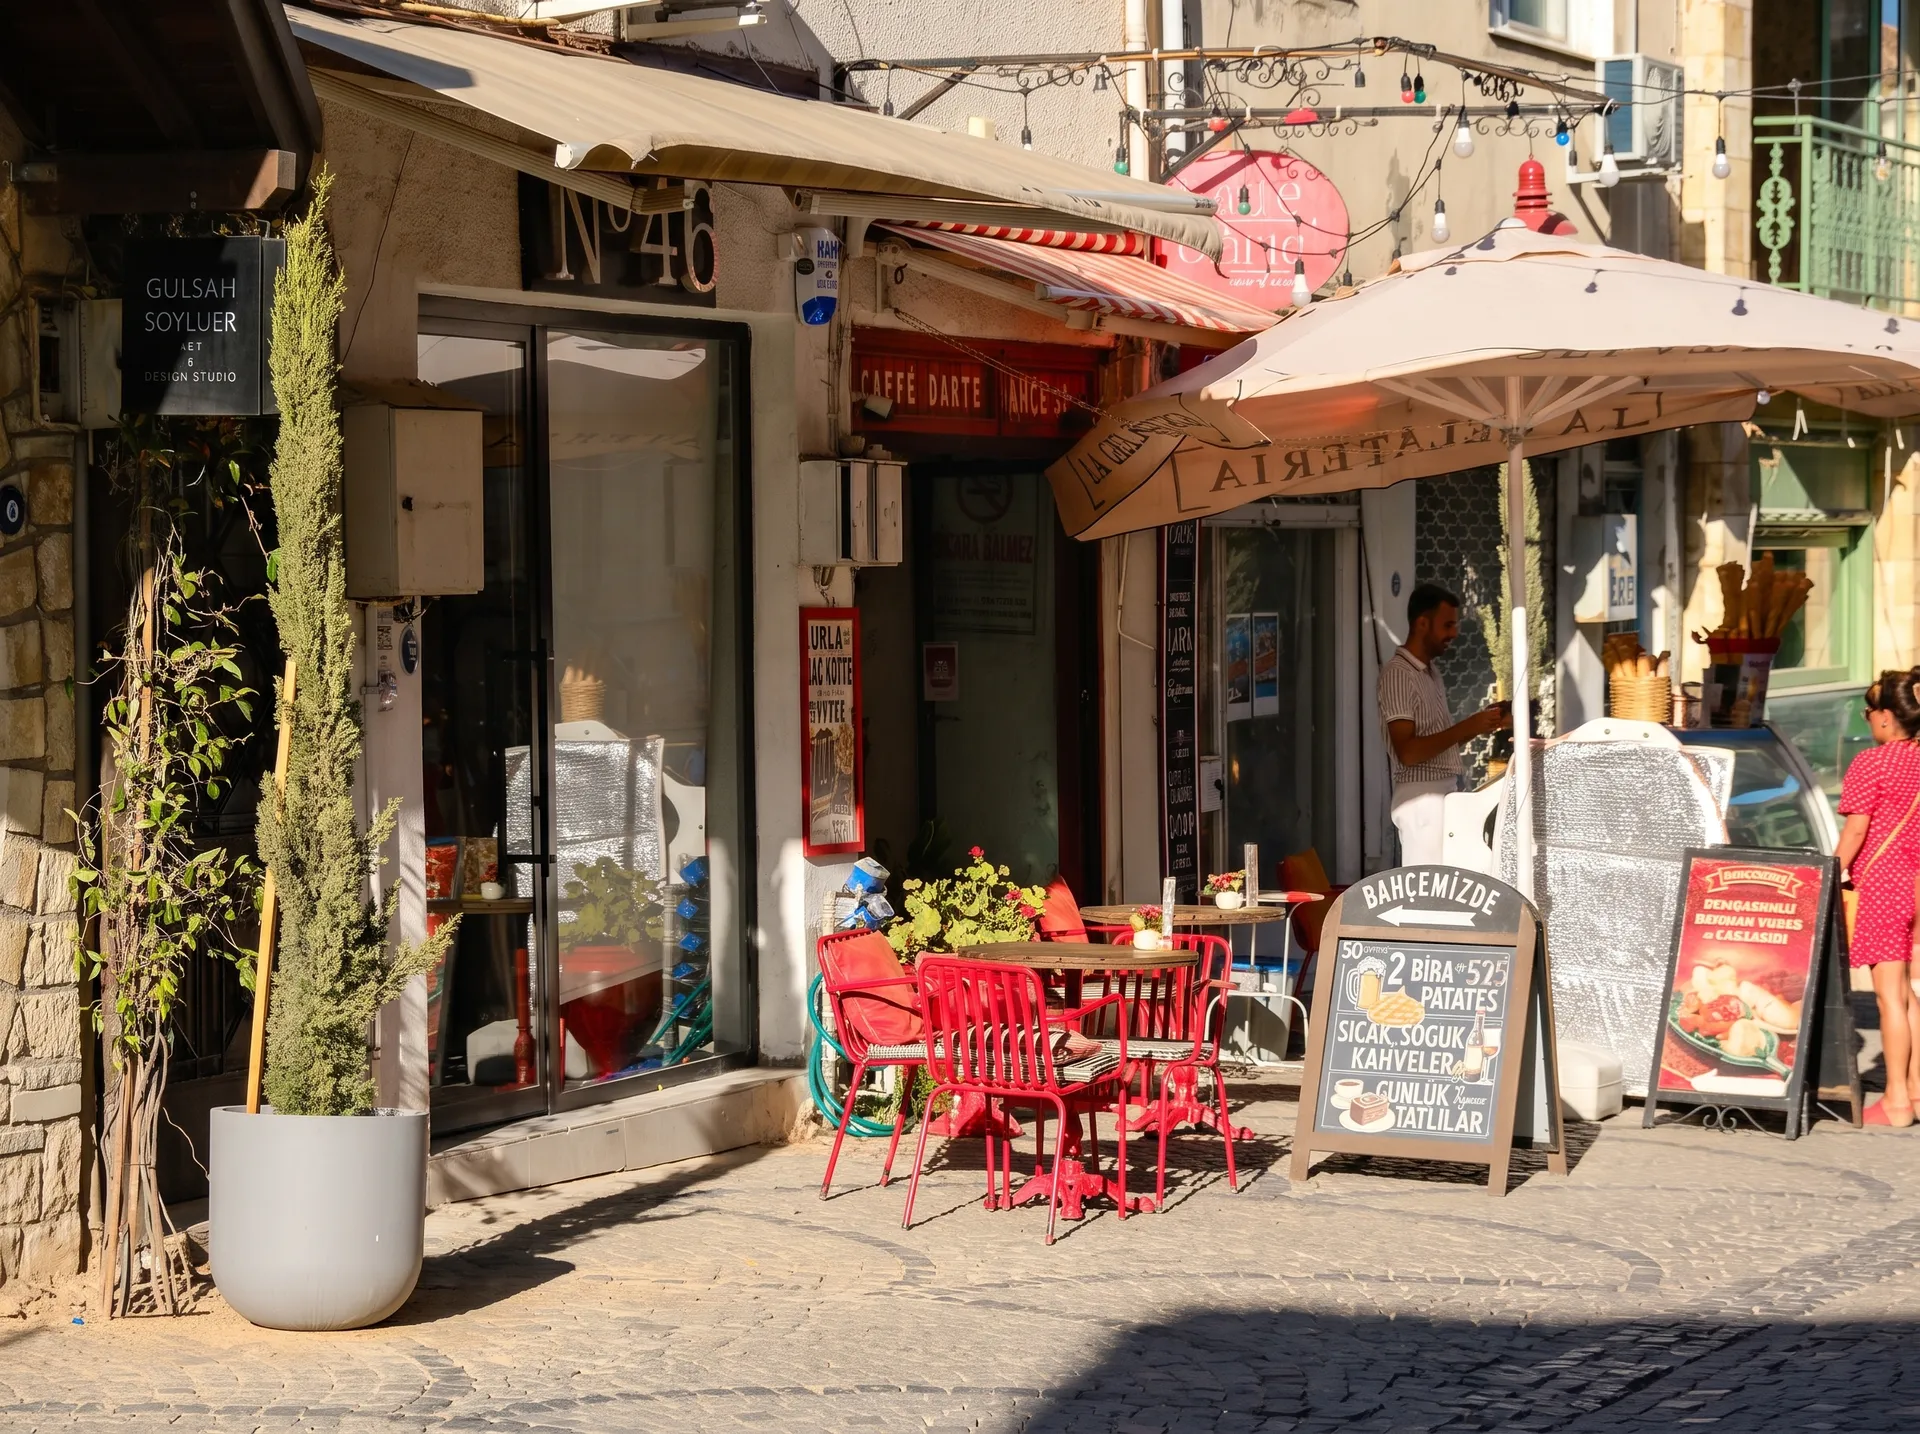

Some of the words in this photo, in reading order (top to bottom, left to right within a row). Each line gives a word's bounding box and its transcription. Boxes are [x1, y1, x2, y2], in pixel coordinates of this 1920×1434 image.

[146, 277, 236, 299] GULSAH
[144, 311, 237, 332] SOYLUER
[144, 371, 188, 382] DESIGN
[192, 371, 237, 382] STUDIO
[929, 373, 981, 409] DARTE
[811, 625, 843, 650] URLA
[1361, 870, 1501, 916] BAHÇEMİZDE
[1341, 941, 1363, 960] 50
[1387, 951, 1406, 986] 2
[1410, 954, 1454, 984] BİRA
[1465, 959, 1509, 988] 525
[1421, 985, 1499, 1012] PATATES
[1350, 1046, 1454, 1076] KAHVELER
[1395, 1105, 1484, 1134] TATLILAR
